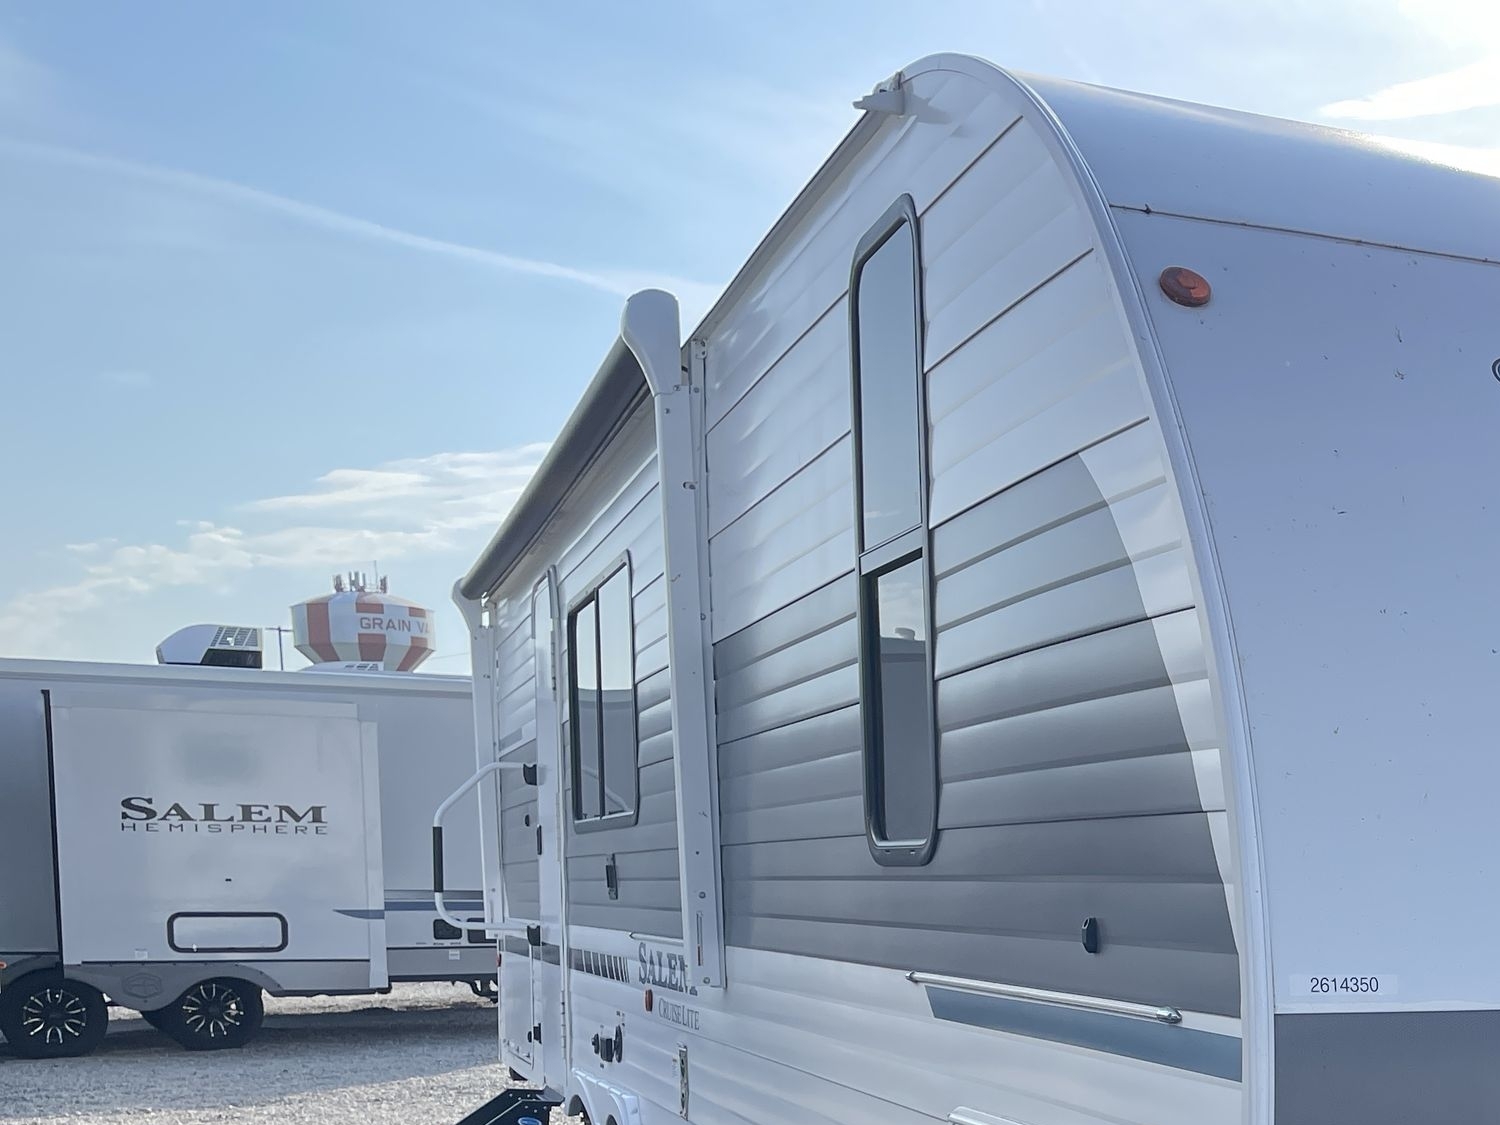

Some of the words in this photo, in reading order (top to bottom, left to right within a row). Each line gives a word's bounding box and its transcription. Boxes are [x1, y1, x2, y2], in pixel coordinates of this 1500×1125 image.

[360, 617, 411, 633] GRAIN
[121, 796, 328, 824] SALEM
[121, 822, 328, 835] HEMISPHERE
[1310, 976, 1379, 994] 2614350
